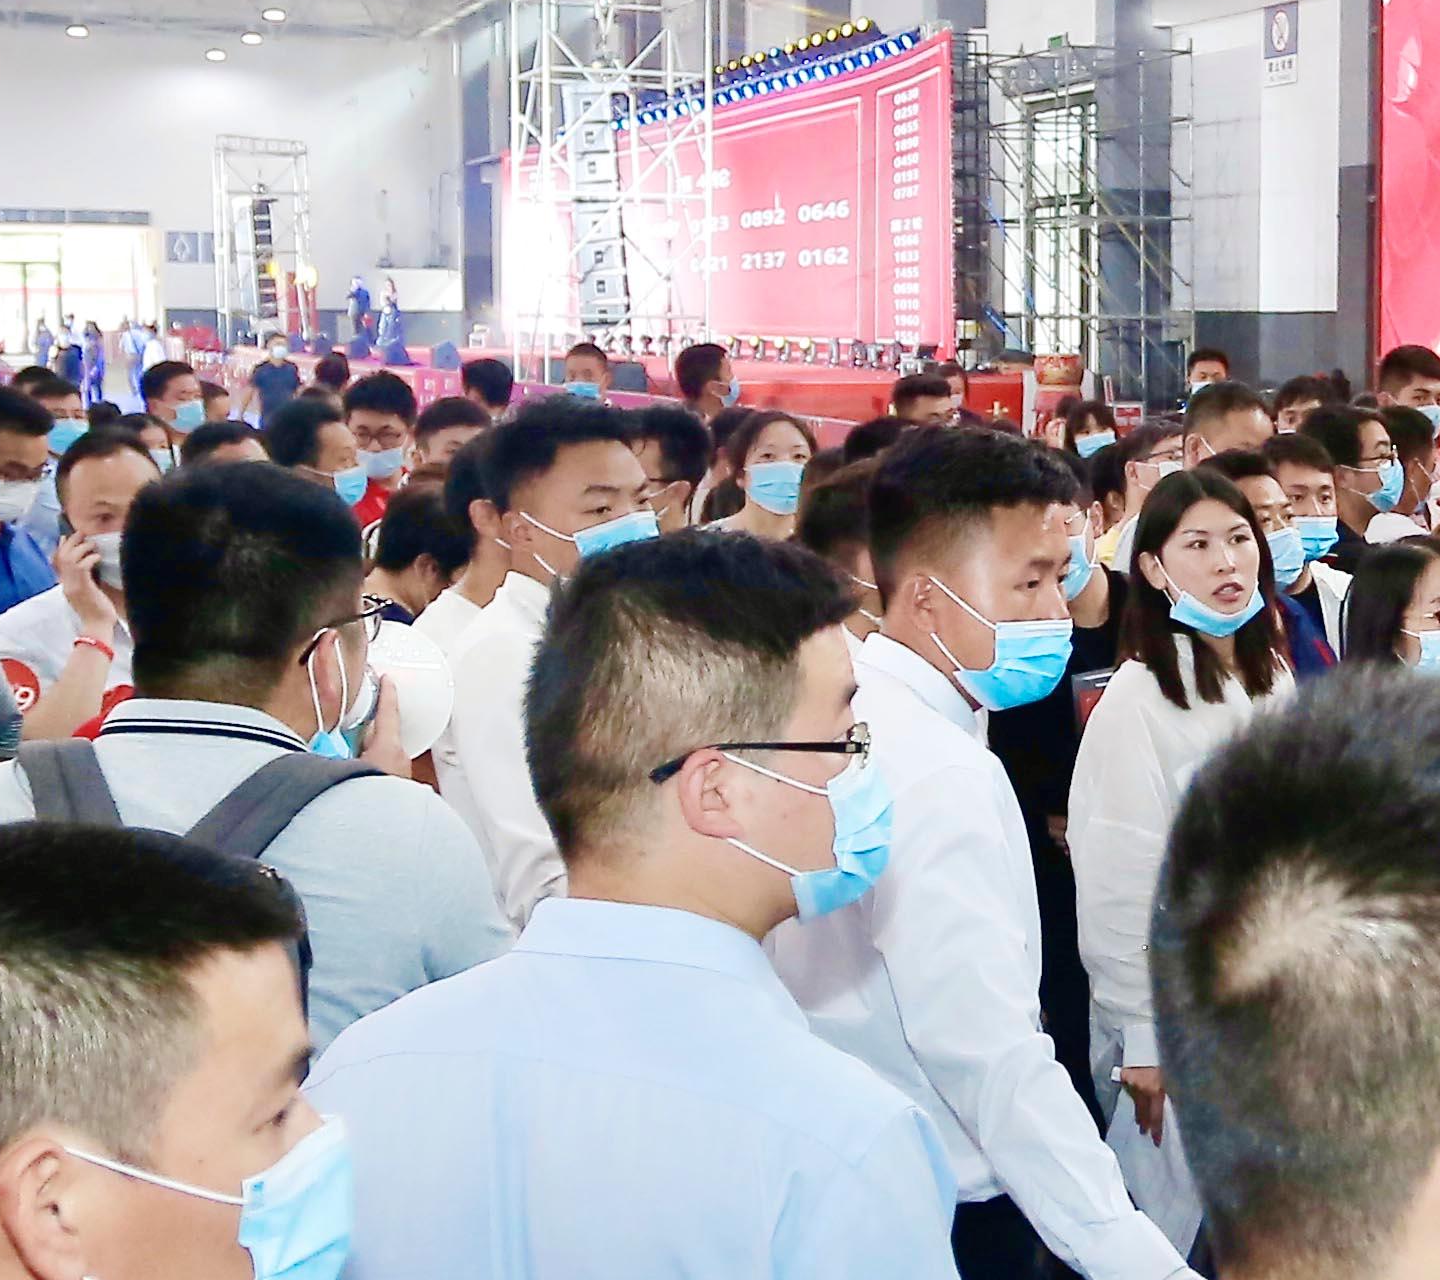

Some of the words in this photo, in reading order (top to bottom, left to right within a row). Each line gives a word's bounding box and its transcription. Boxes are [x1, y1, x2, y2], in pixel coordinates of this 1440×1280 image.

[740, 209, 785, 229] 0892
[797, 200, 850, 223] 0646
[741, 251, 786, 271] 2137
[798, 246, 850, 267] 0162
[894, 298, 919, 311] 1010
